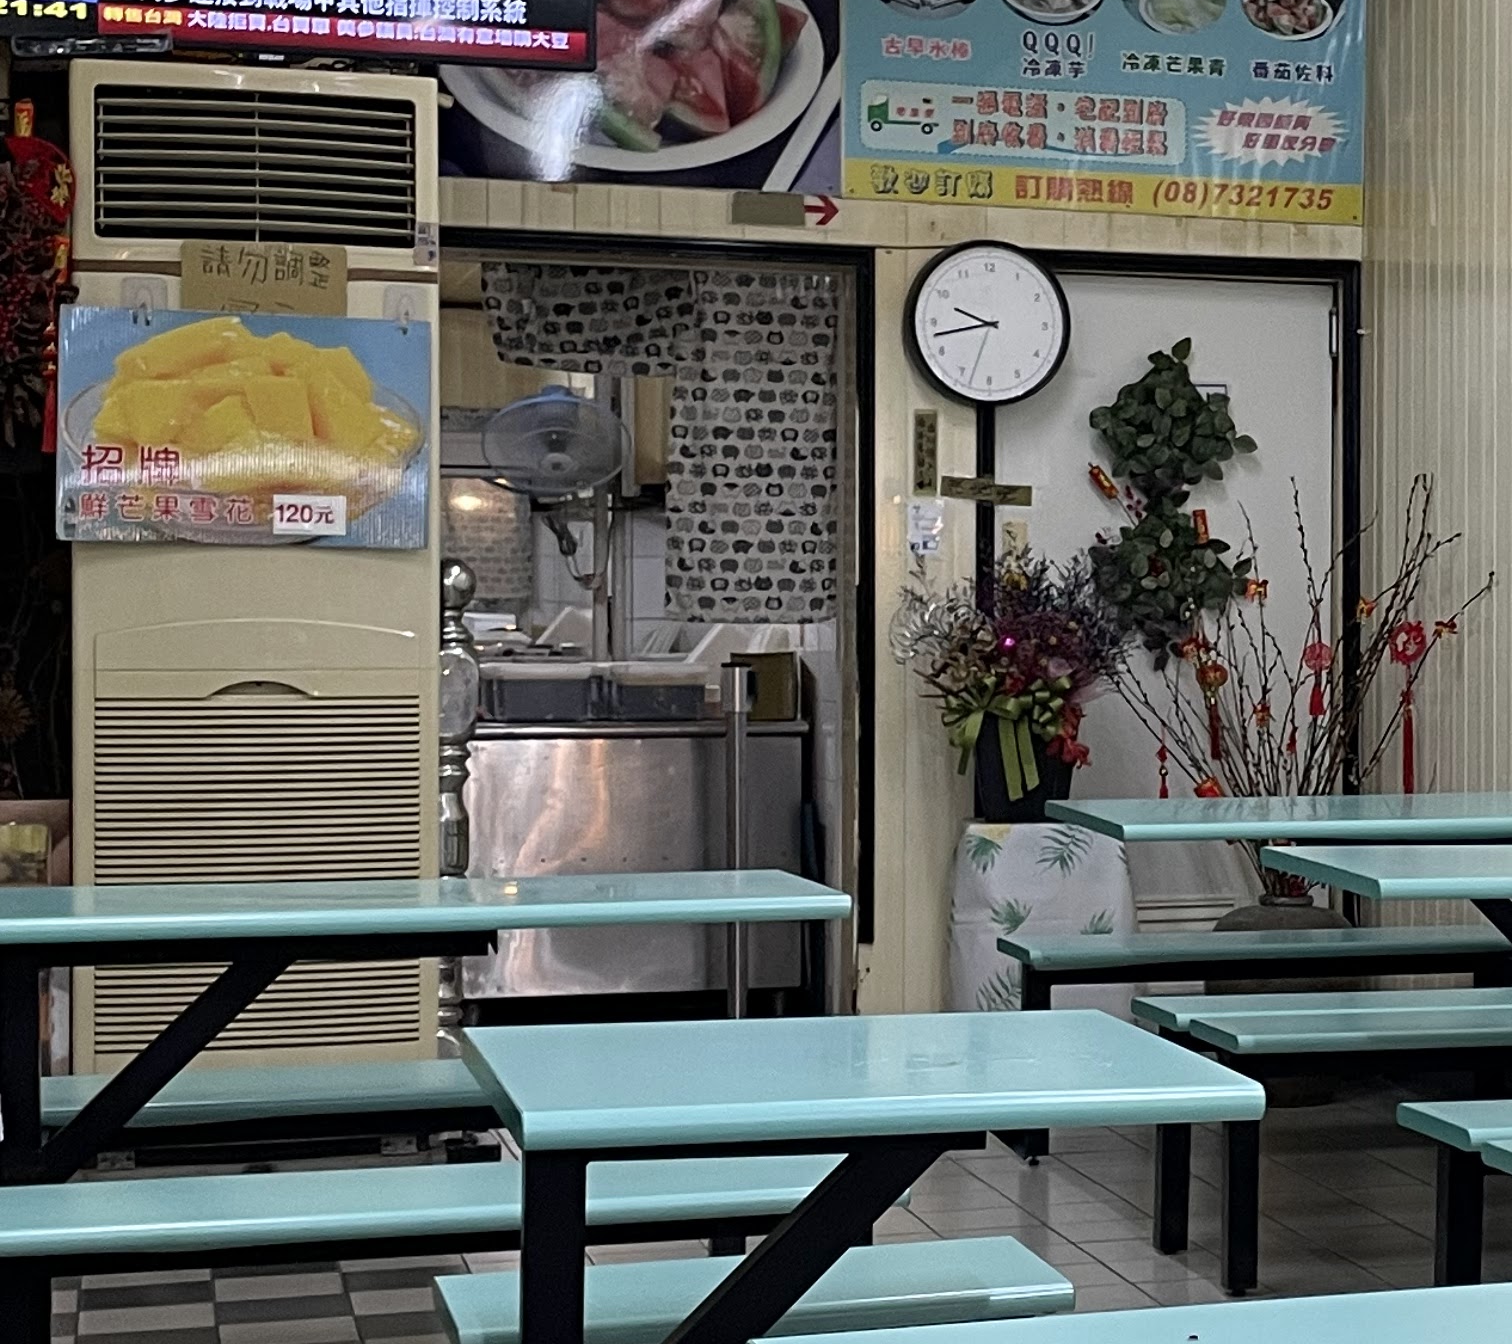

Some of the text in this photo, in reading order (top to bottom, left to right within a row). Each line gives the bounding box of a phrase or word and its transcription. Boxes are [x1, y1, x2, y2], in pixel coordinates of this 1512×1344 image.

[1022, 58, 1086, 78] 冷凍芋
[1153, 179, 1334, 210] (08)7321735
[201, 244, 331, 291] 請勿調整
[81, 444, 181, 486] 招牌
[79, 494, 254, 524] 鮮芒果雪花
[275, 504, 335, 525] 120元
